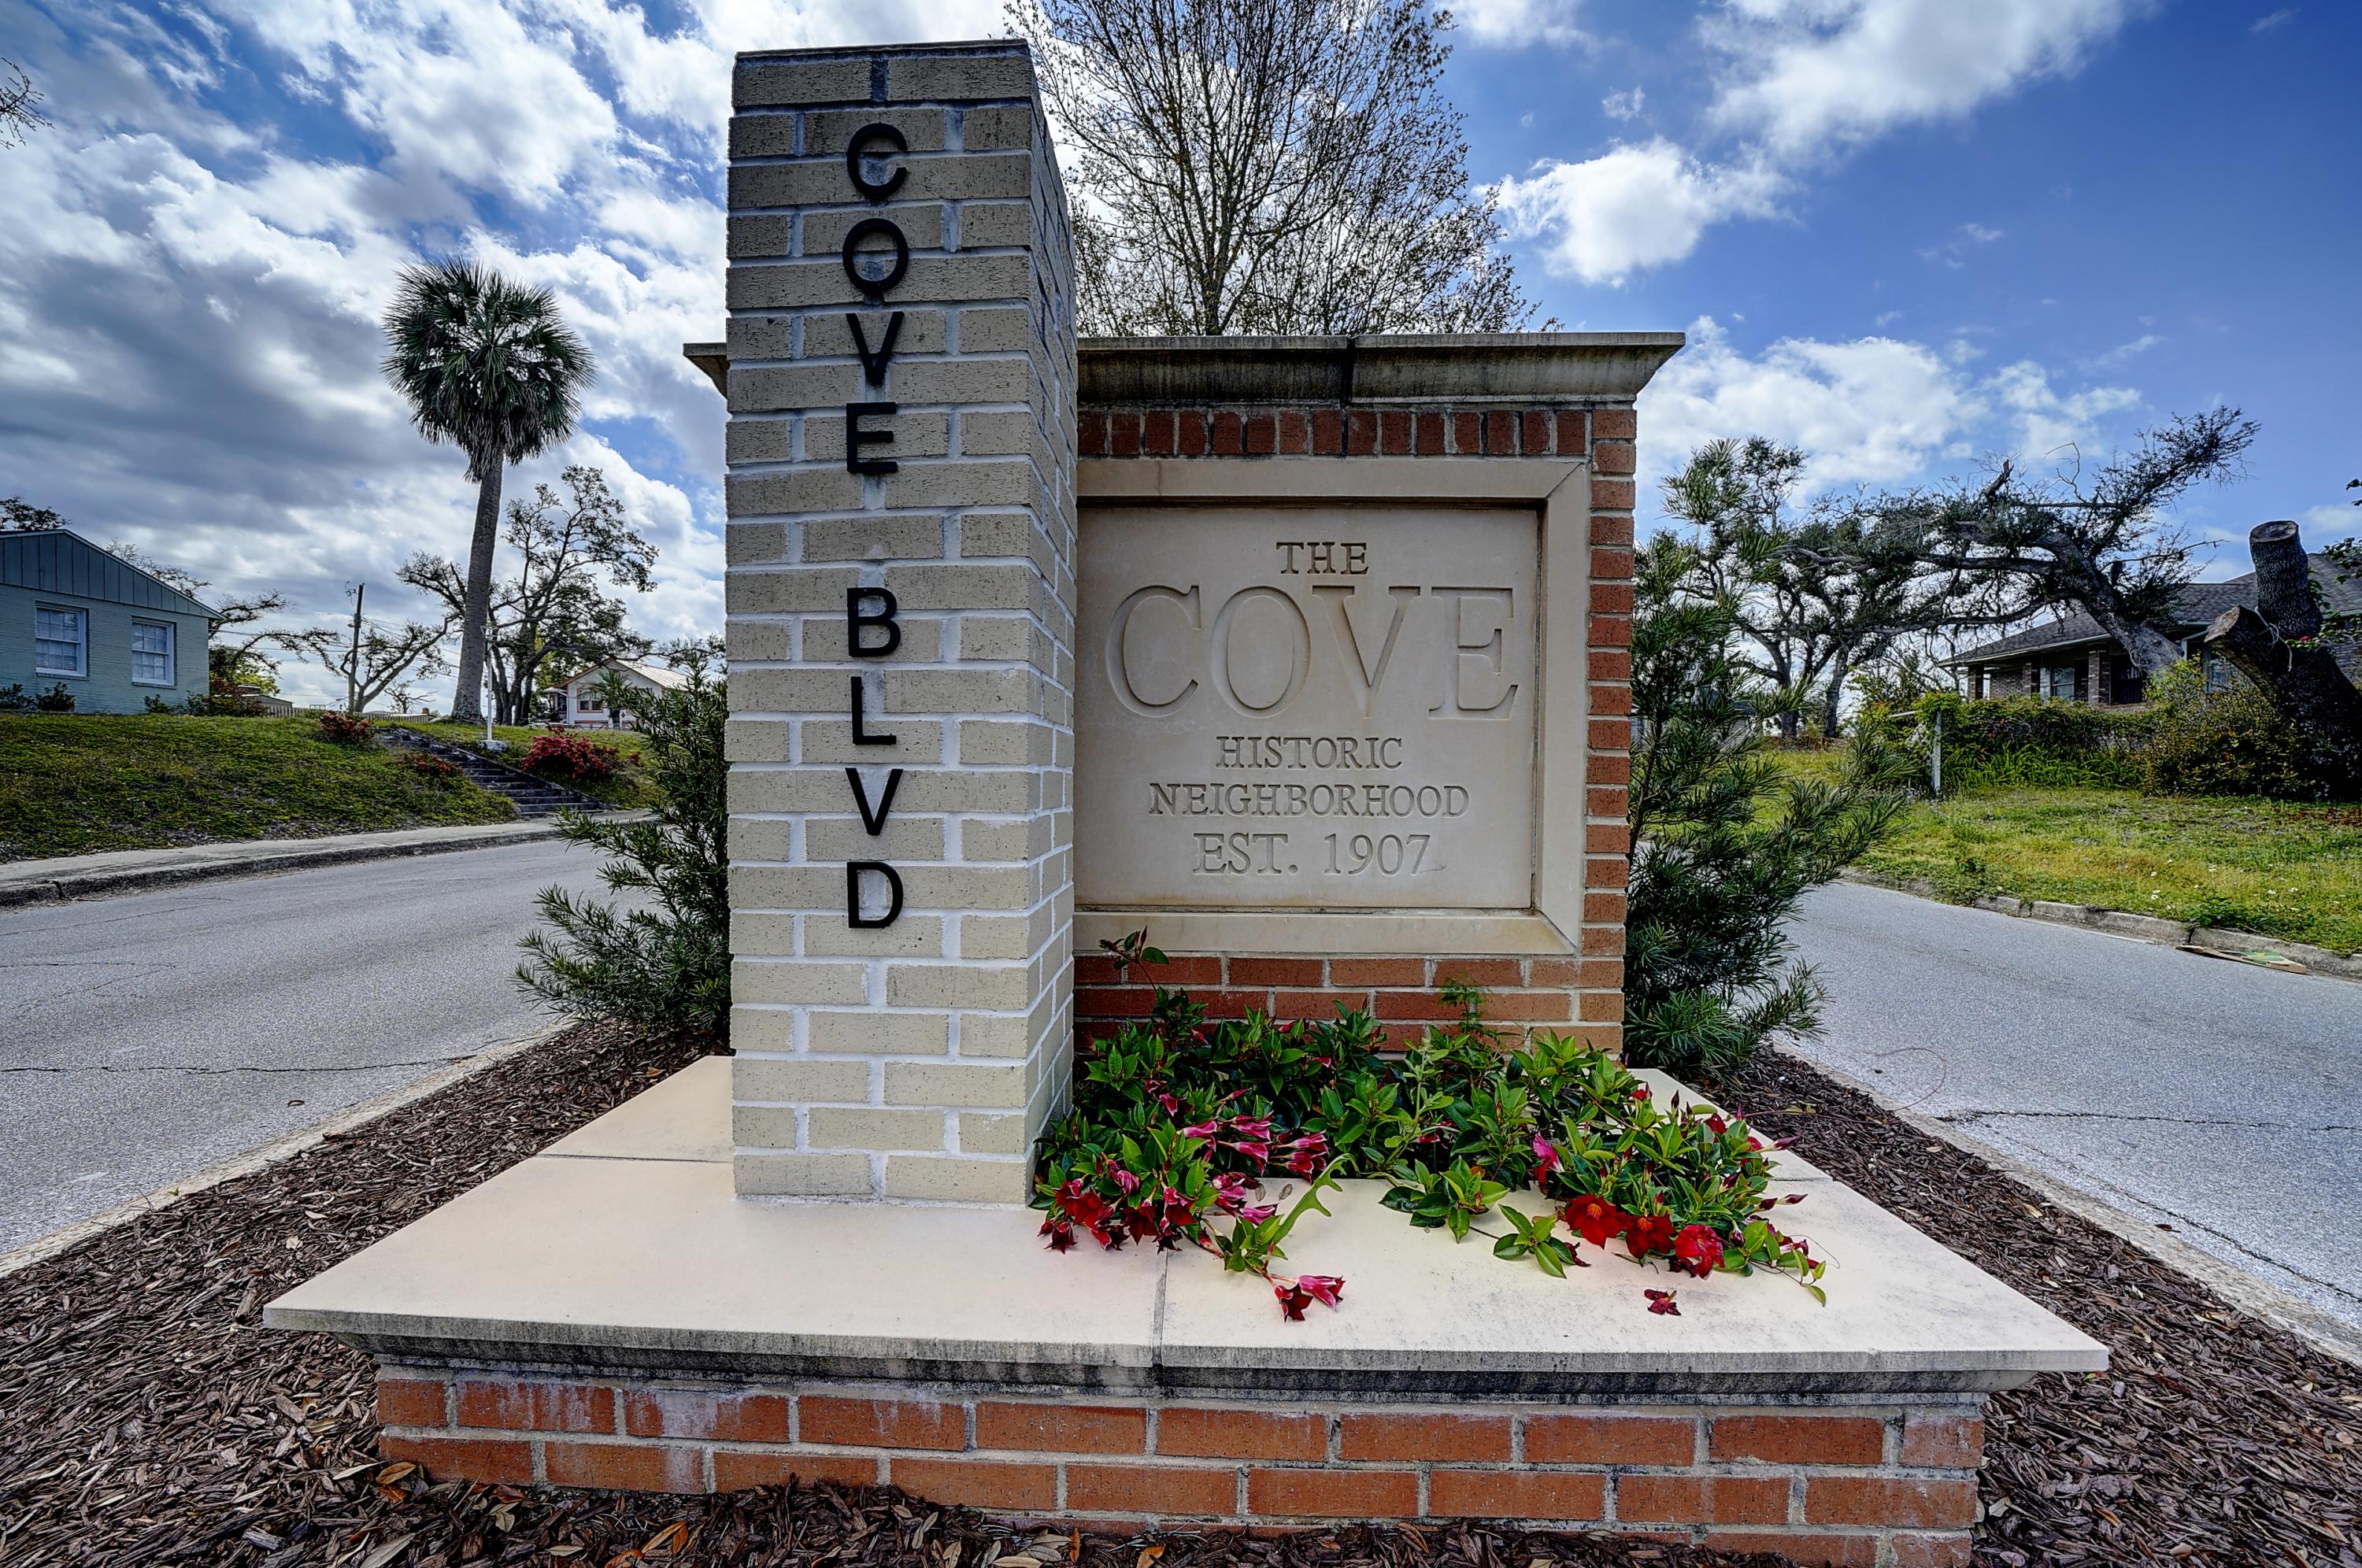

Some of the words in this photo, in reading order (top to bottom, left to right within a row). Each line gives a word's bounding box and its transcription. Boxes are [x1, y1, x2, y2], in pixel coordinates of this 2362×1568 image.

[842, 123, 909, 474] COVE
[1275, 541, 1369, 575] THE
[1105, 584, 1519, 720] COVE
[845, 587, 904, 929] BLVD
[1216, 736, 1402, 769] HISTORIC
[1149, 782, 1469, 818] NEIGHBORHOOD
[1193, 832, 1298, 875] EST.
[1324, 834, 1431, 875] 1907
